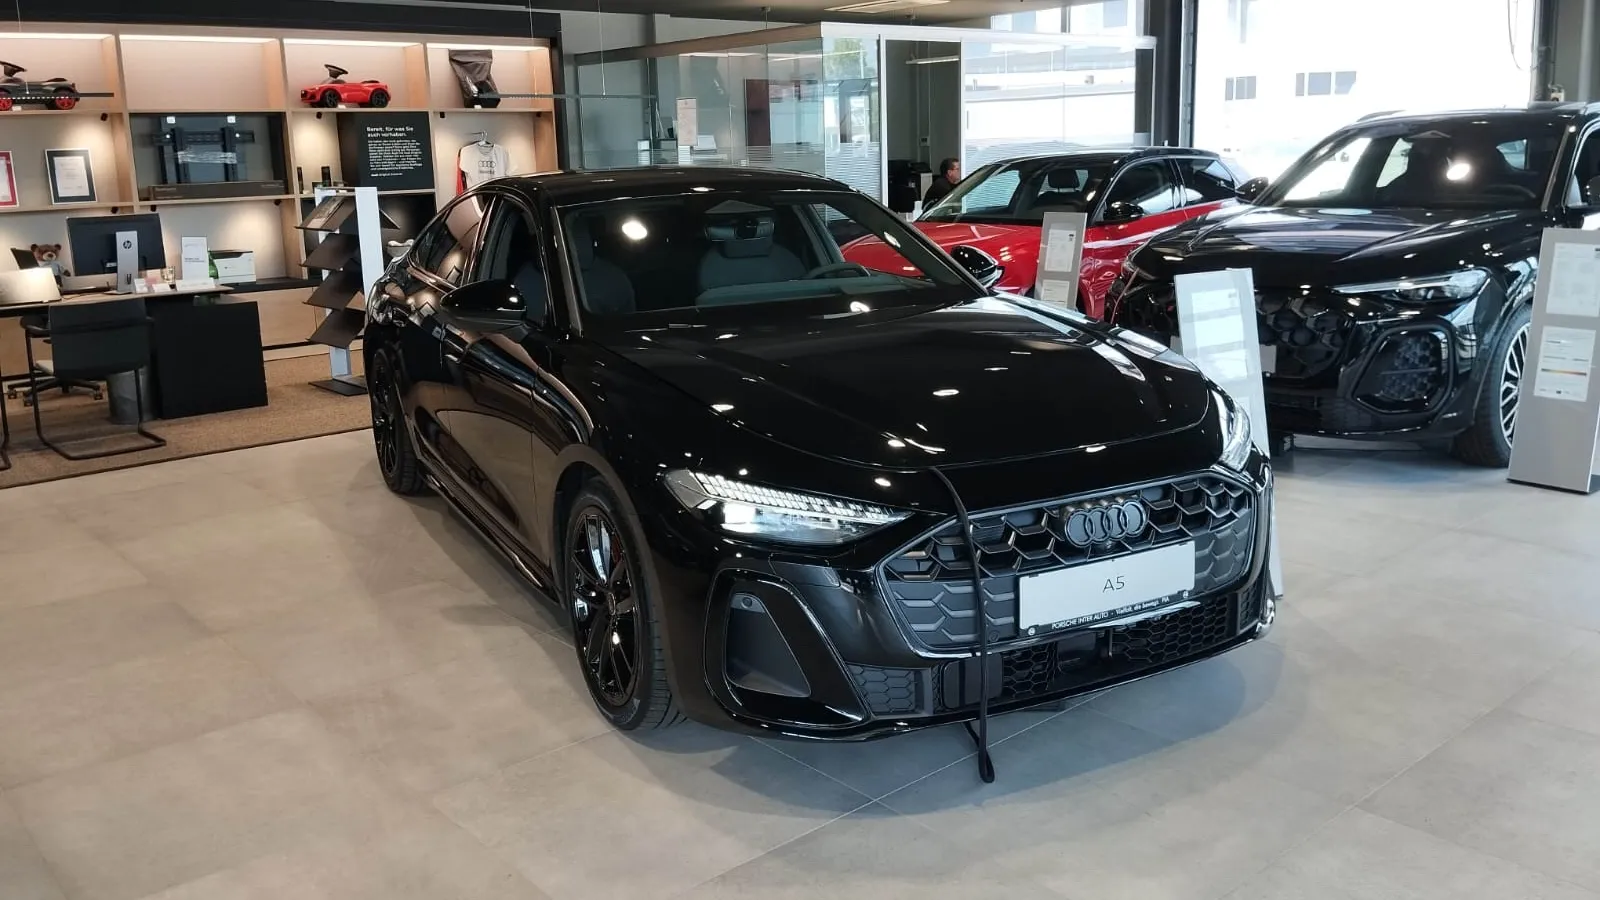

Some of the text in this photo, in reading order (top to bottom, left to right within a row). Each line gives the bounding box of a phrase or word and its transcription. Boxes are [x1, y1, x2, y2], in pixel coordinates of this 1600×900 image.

[1102, 575, 1125, 593] A5
[1051, 619, 1077, 630] PORSCHE
[1077, 614, 1093, 624] INTER
[1093, 611, 1109, 621] AUTO
